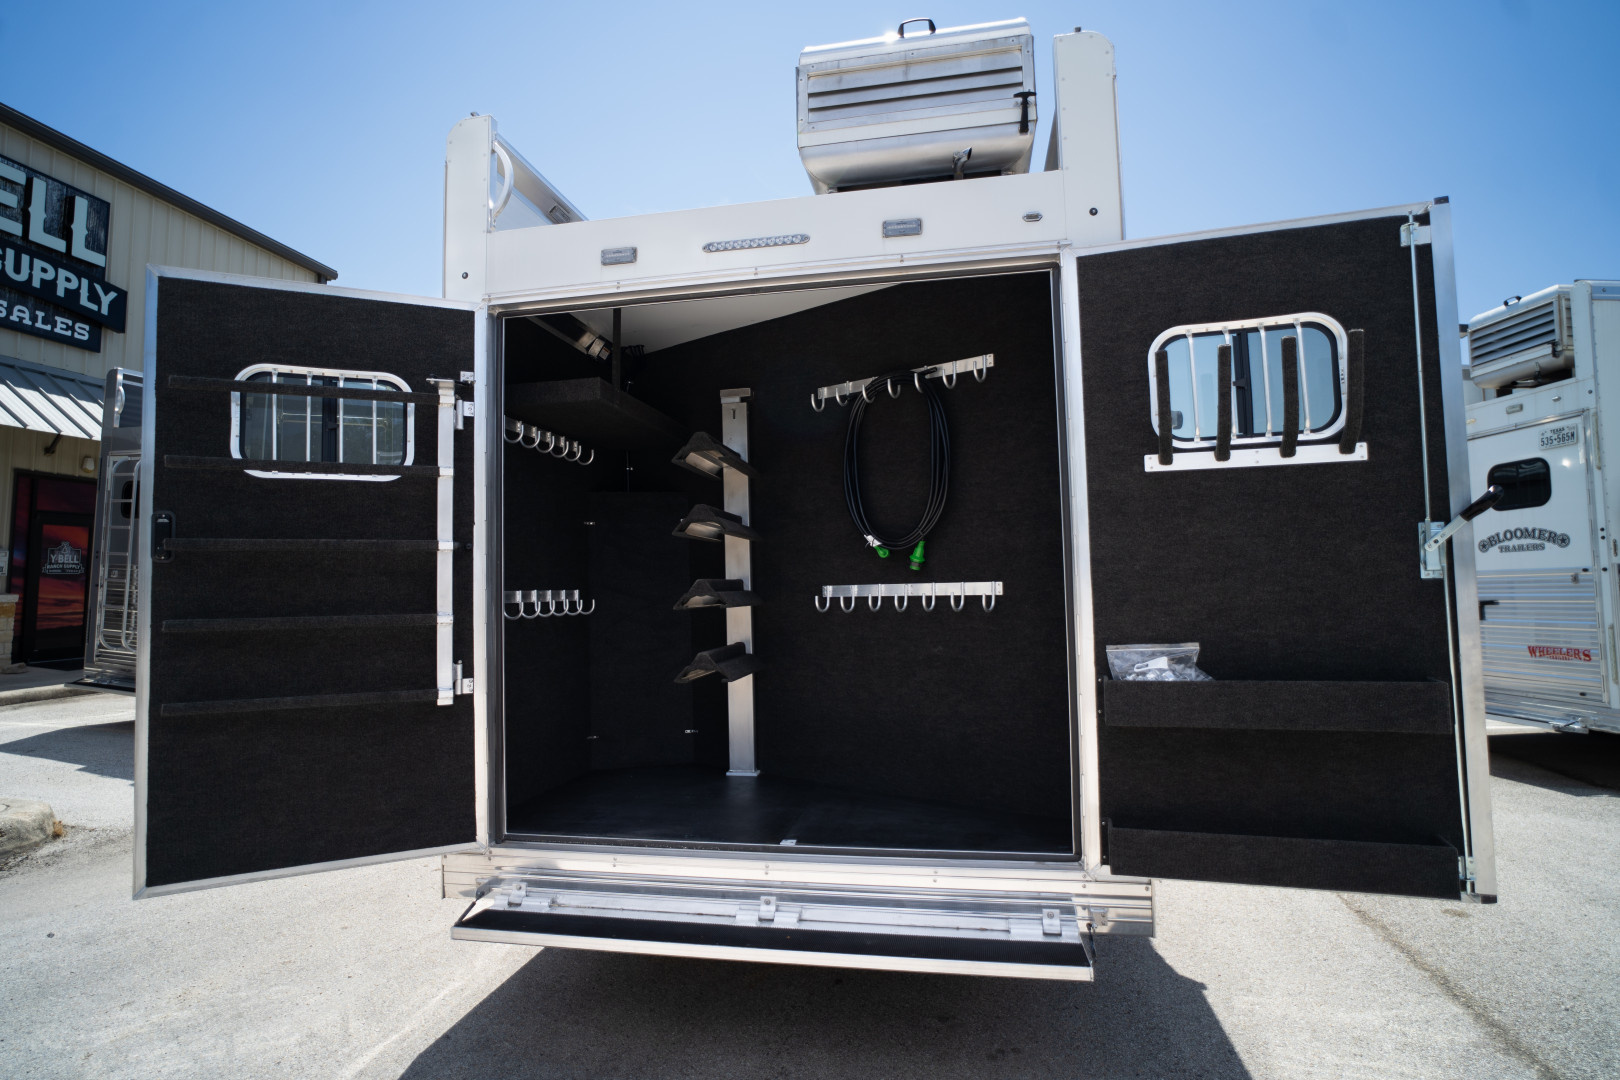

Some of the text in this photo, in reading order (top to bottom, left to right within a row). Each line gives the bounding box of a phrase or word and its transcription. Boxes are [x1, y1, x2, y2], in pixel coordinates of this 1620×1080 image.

[0, 246, 118, 316] UPPLY
[1486, 526, 1558, 549] BLOOMER
[1498, 542, 1545, 553] TRAILERS
[58, 554, 79, 563] BELL
